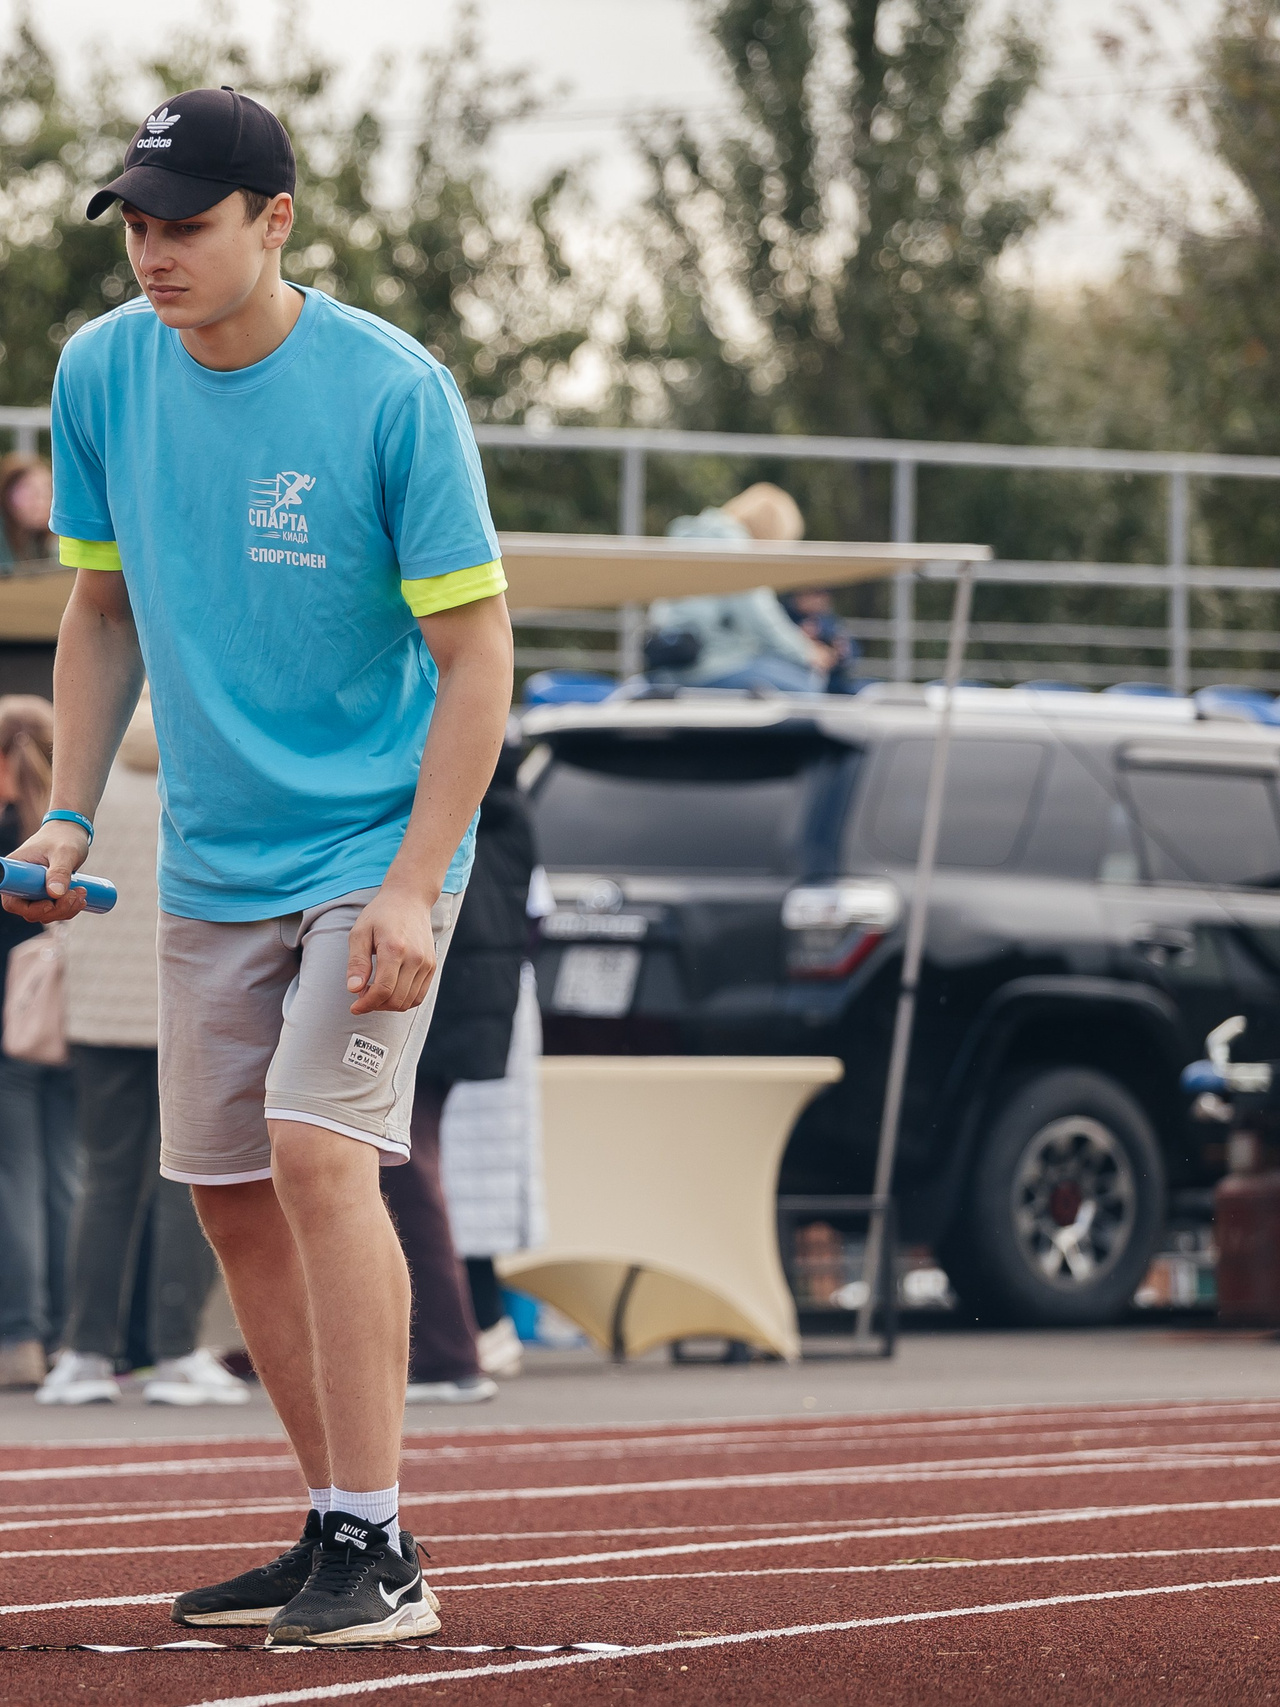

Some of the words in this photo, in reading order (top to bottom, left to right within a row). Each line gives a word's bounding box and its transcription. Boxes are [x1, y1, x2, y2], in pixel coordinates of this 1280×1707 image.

[136, 136, 172, 148] adidas
[248, 508, 308, 532] СПАРТА
[282, 531, 308, 544] КИАДА
[251, 547, 326, 569] СПОРТСМЕН
[350, 1051, 380, 1069] HOMME
[340, 1523, 368, 1540] NIKE
